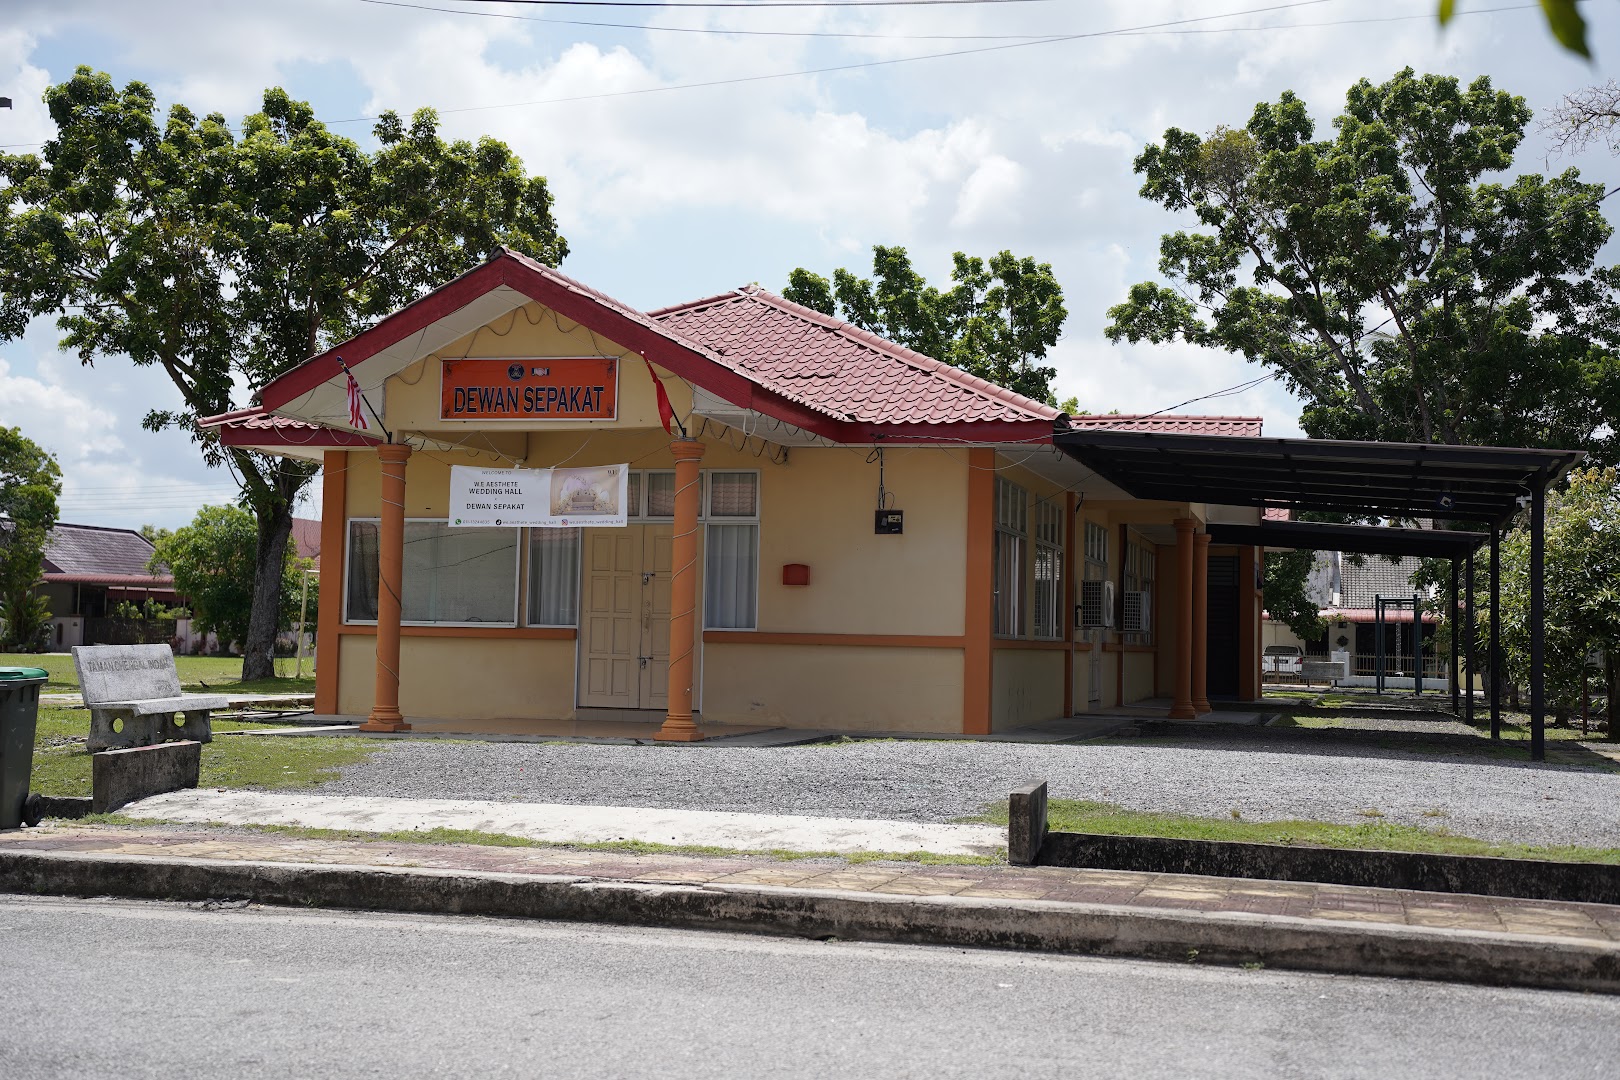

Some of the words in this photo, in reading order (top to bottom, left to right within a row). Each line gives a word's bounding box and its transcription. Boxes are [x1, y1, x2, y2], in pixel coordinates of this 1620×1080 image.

[453, 385, 519, 414] DEWAN
[523, 385, 605, 414] SEPAKAT
[87, 660, 114, 673] TAMAN
